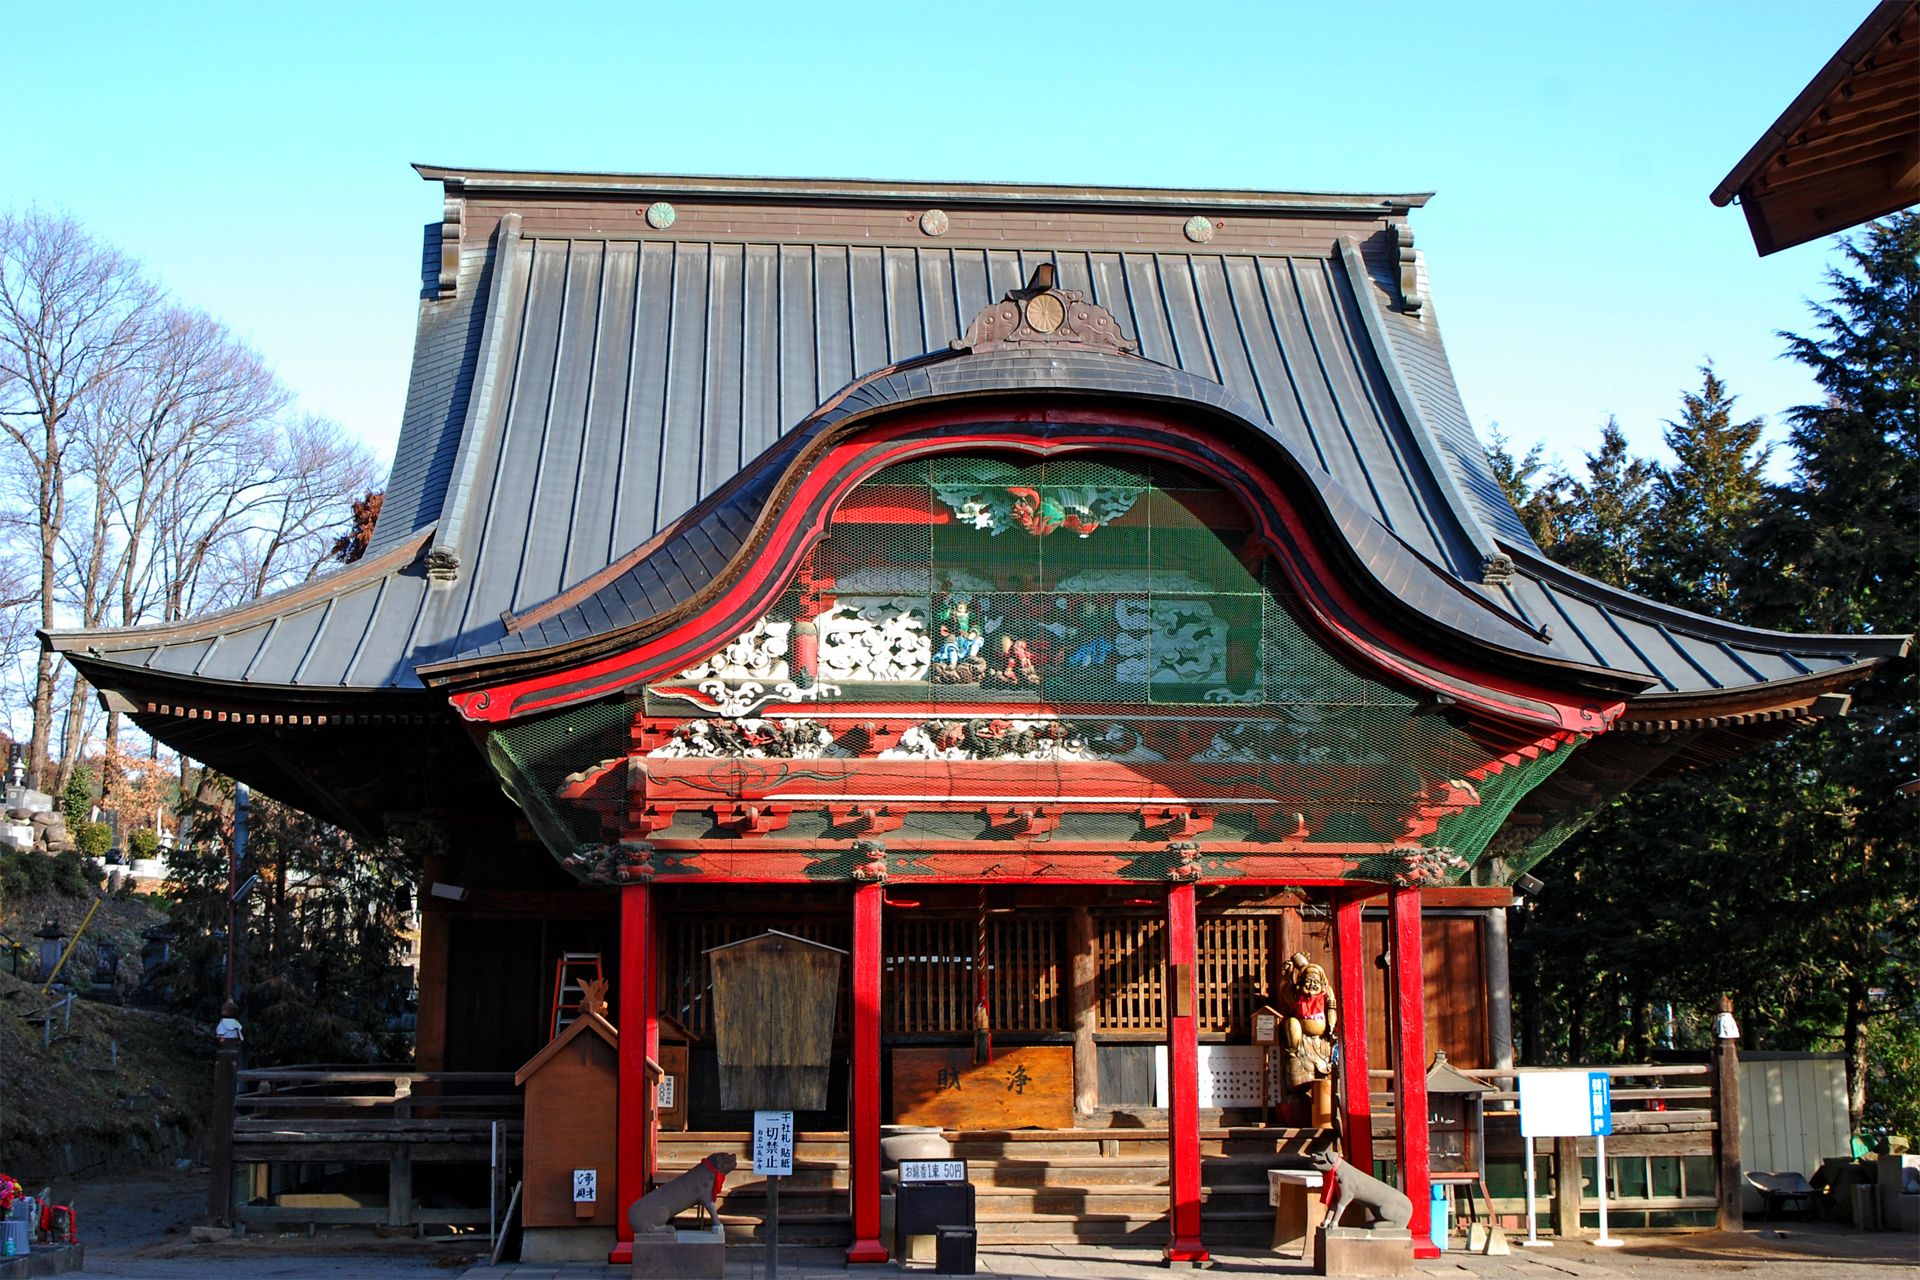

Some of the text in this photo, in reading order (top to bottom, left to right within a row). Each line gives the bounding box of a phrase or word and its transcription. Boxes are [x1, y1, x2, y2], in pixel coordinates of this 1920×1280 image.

[765, 1118, 779, 1168] 一切禁止
[943, 1163, 962, 1178] 50円
